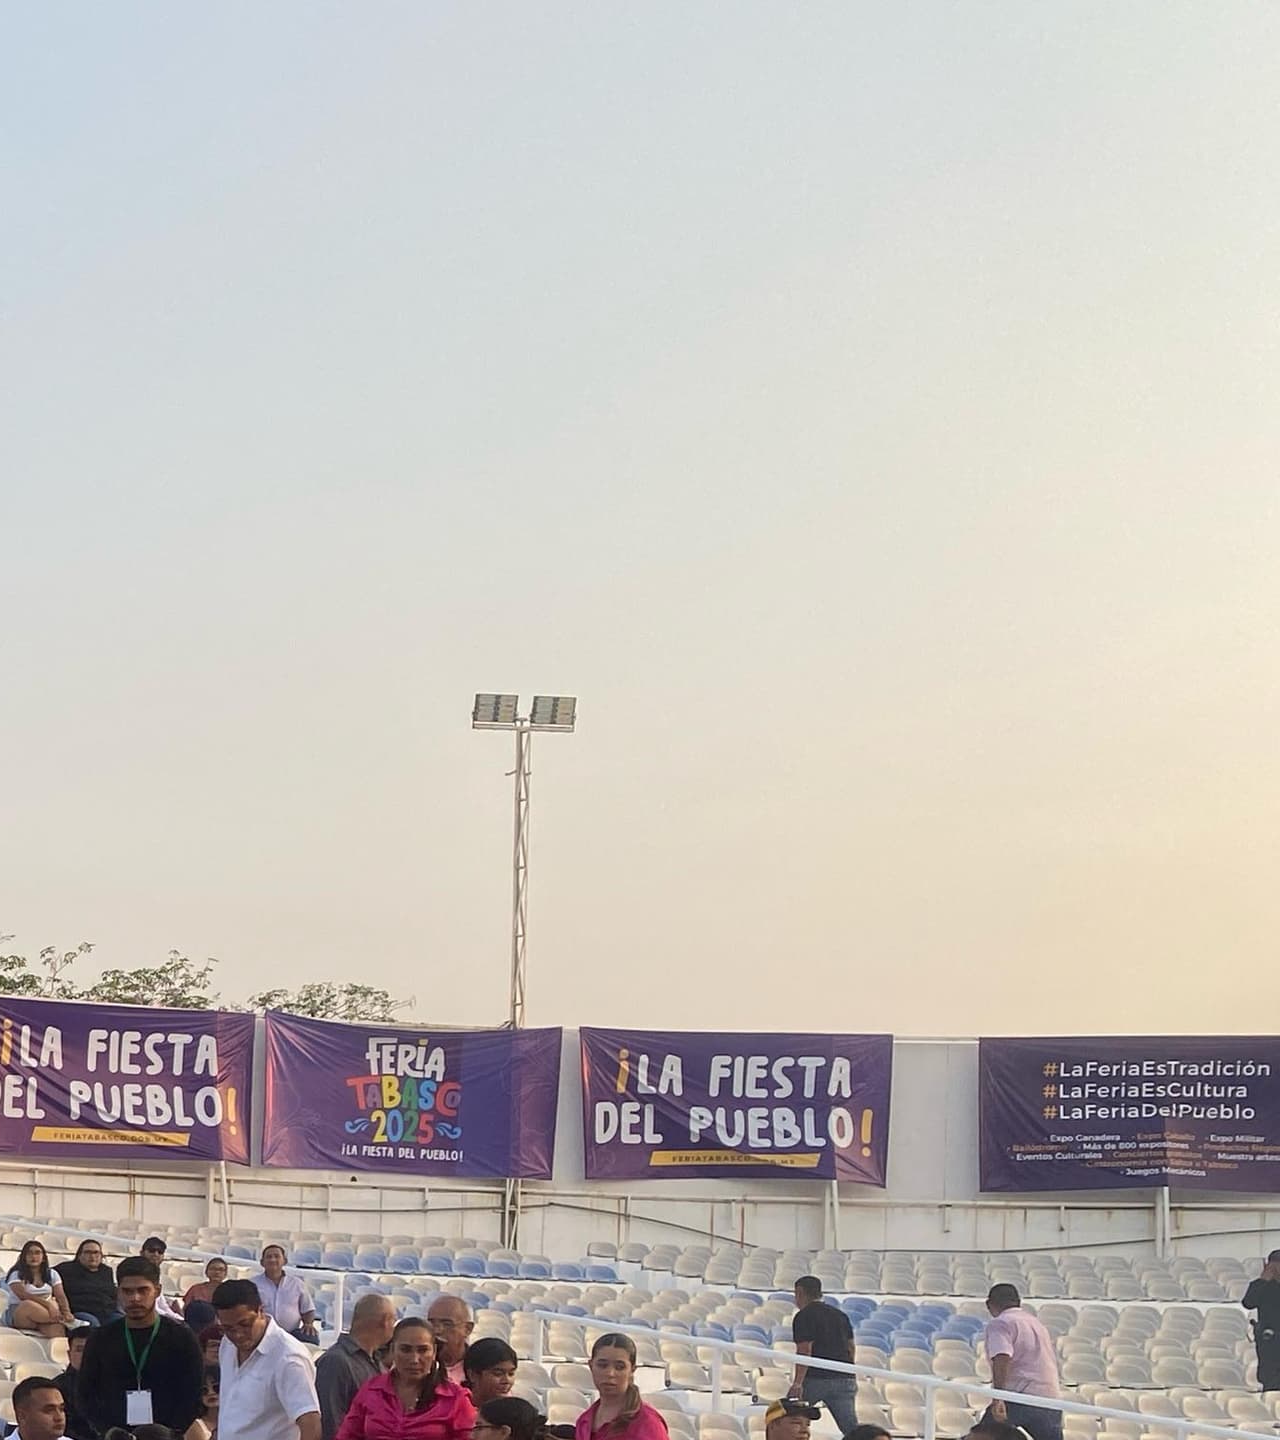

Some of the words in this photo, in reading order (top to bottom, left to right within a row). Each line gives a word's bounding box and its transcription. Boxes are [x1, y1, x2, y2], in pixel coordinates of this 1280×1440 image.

[87, 1029, 218, 1077] FIESTA
[366, 1037, 445, 1082] FERIA
[709, 1055, 852, 1099] FIESTA
[1043, 1060, 1271, 1077] #LaFeriaEsTradición
[1043, 1082, 1248, 1099] #LaFeriaEsCultura
[69, 1080, 237, 1136] PUEBLO!
[1043, 1104, 1256, 1120] #LaFeriaDelPueblo
[371, 1109, 435, 1144] 2025
[595, 1101, 663, 1144] DEL
[690, 1106, 873, 1158] PUEBLO!
[1050, 1134, 1074, 1143] Expo
[362, 1145, 394, 1158] FIESTA
[398, 1146, 415, 1159] DEL
[420, 1148, 464, 1163] PUEBLO!
[1016, 1153, 1053, 1161] Eventos
